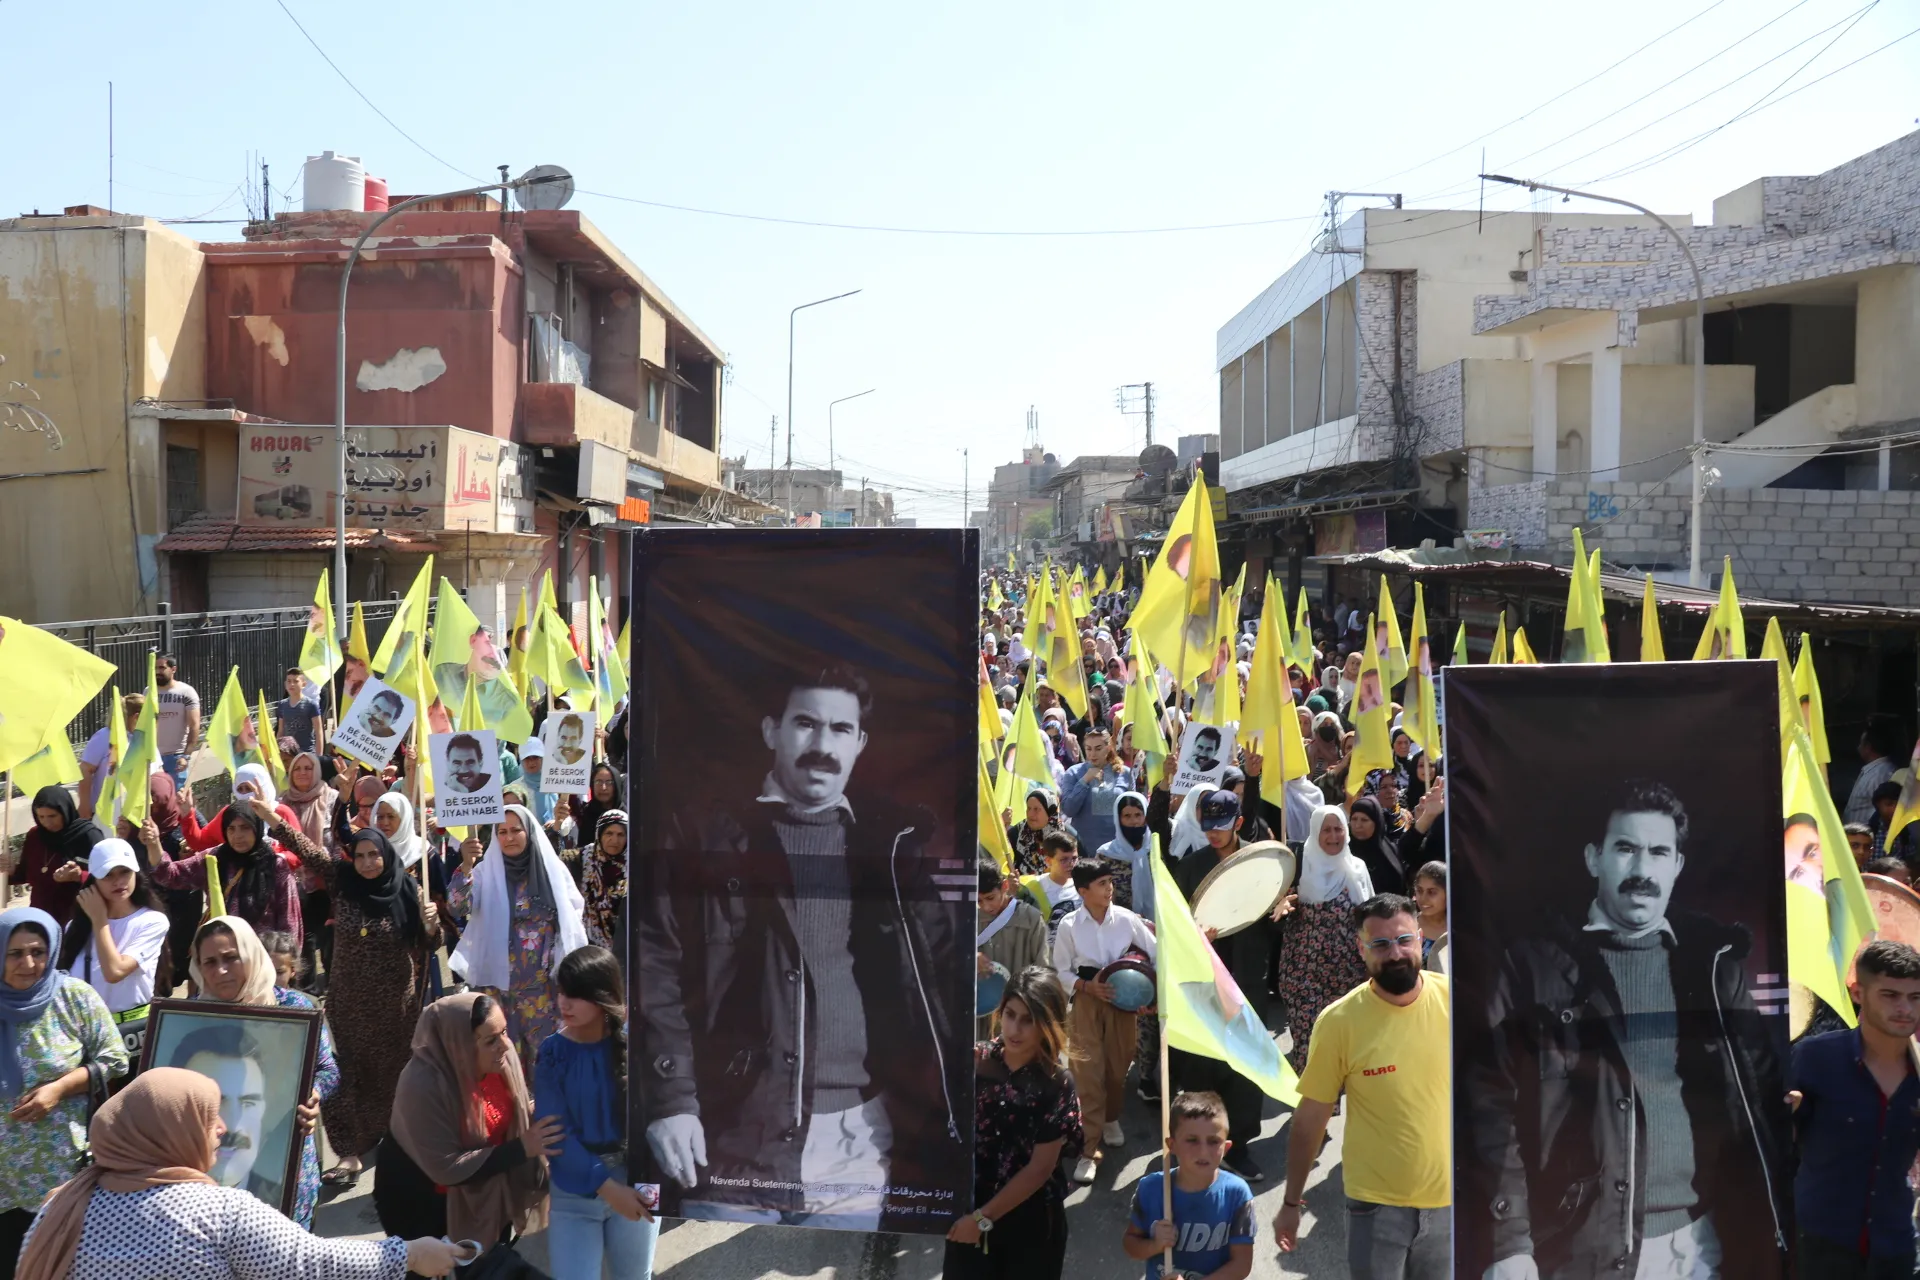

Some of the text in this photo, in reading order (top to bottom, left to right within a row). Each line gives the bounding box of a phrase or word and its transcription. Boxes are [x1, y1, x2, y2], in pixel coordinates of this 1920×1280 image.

[345, 499, 429, 522] جديدة
[338, 732, 386, 763] JIYAN NABE
[360, 734, 388, 754] SEROK
[560, 768, 585, 776] SEROK
[545, 777, 586, 786] JIYAN NABE
[1192, 774, 1216, 783] SEROK
[461, 795, 495, 806] SEROK
[442, 806, 499, 818] JIYAN NABE
[709, 1175, 750, 1187] Navenda
[892, 1186, 933, 1199] محروقات
